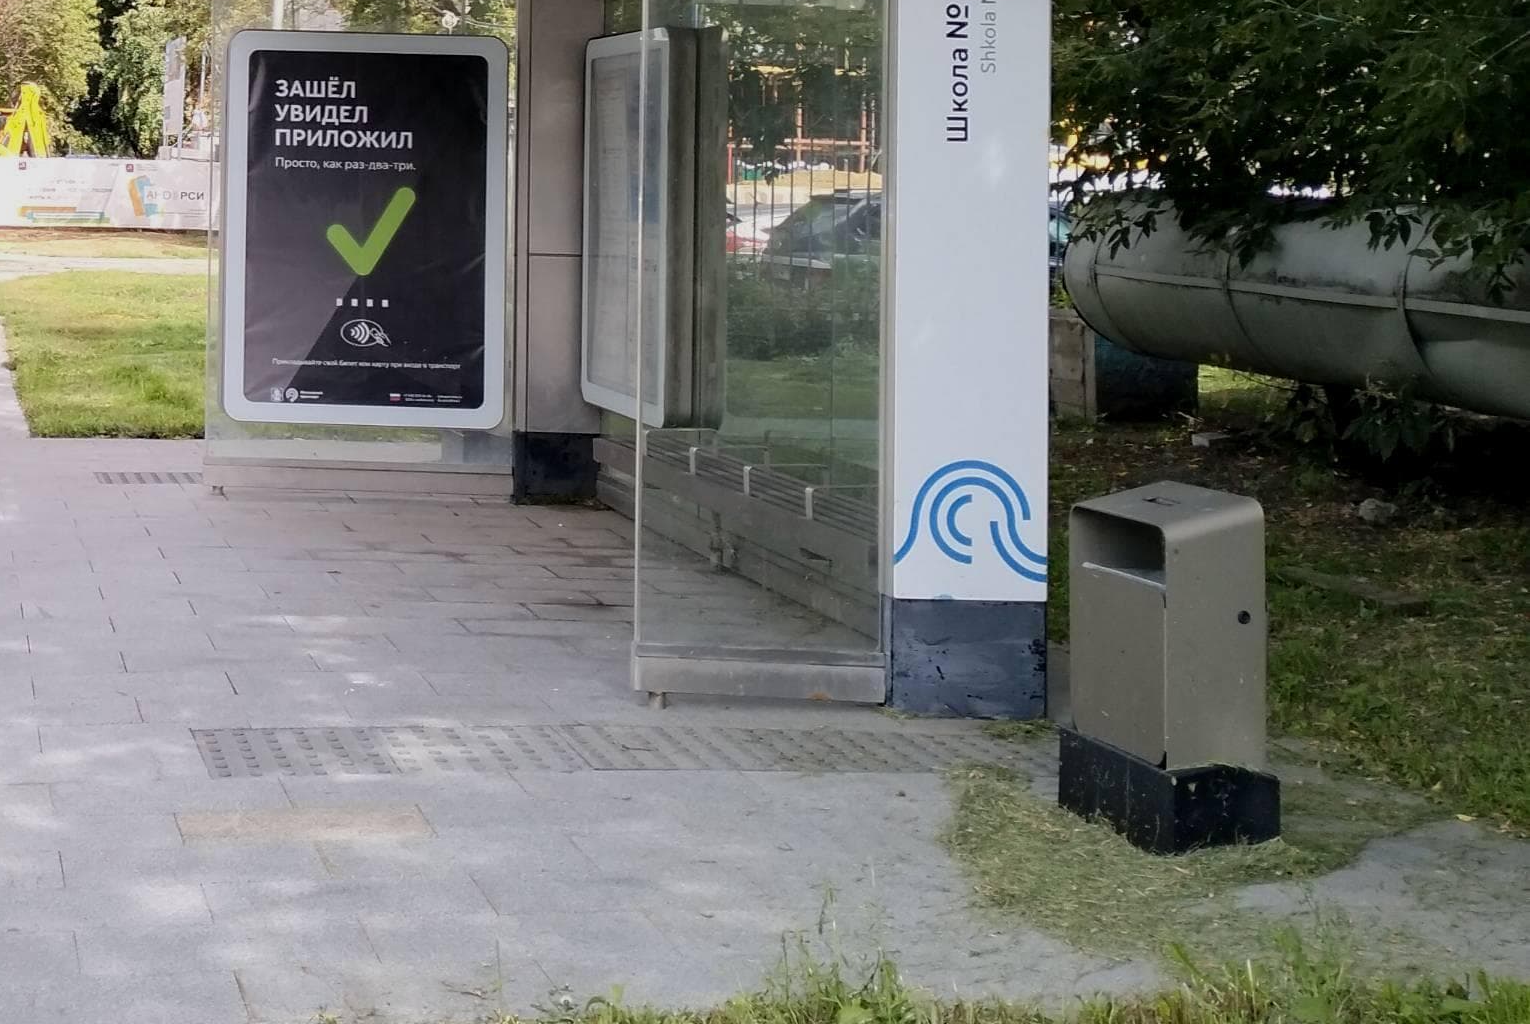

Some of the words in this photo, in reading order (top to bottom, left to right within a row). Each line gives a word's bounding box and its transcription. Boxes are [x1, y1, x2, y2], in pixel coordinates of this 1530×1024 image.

[946, 3, 969, 39] №
[980, 10, 997, 74] Shkola
[274, 76, 356, 99] ЗАШЁЛ
[946, 48, 969, 143] Школа
[274, 104, 368, 126] УВИДЕЛ
[274, 128, 413, 150] ПРИЛОЖИЛ
[275, 156, 320, 170] Просто,
[323, 160, 342, 169] как
[344, 160, 416, 172] раз-два-три.
[180, 191, 205, 201] РСИ
